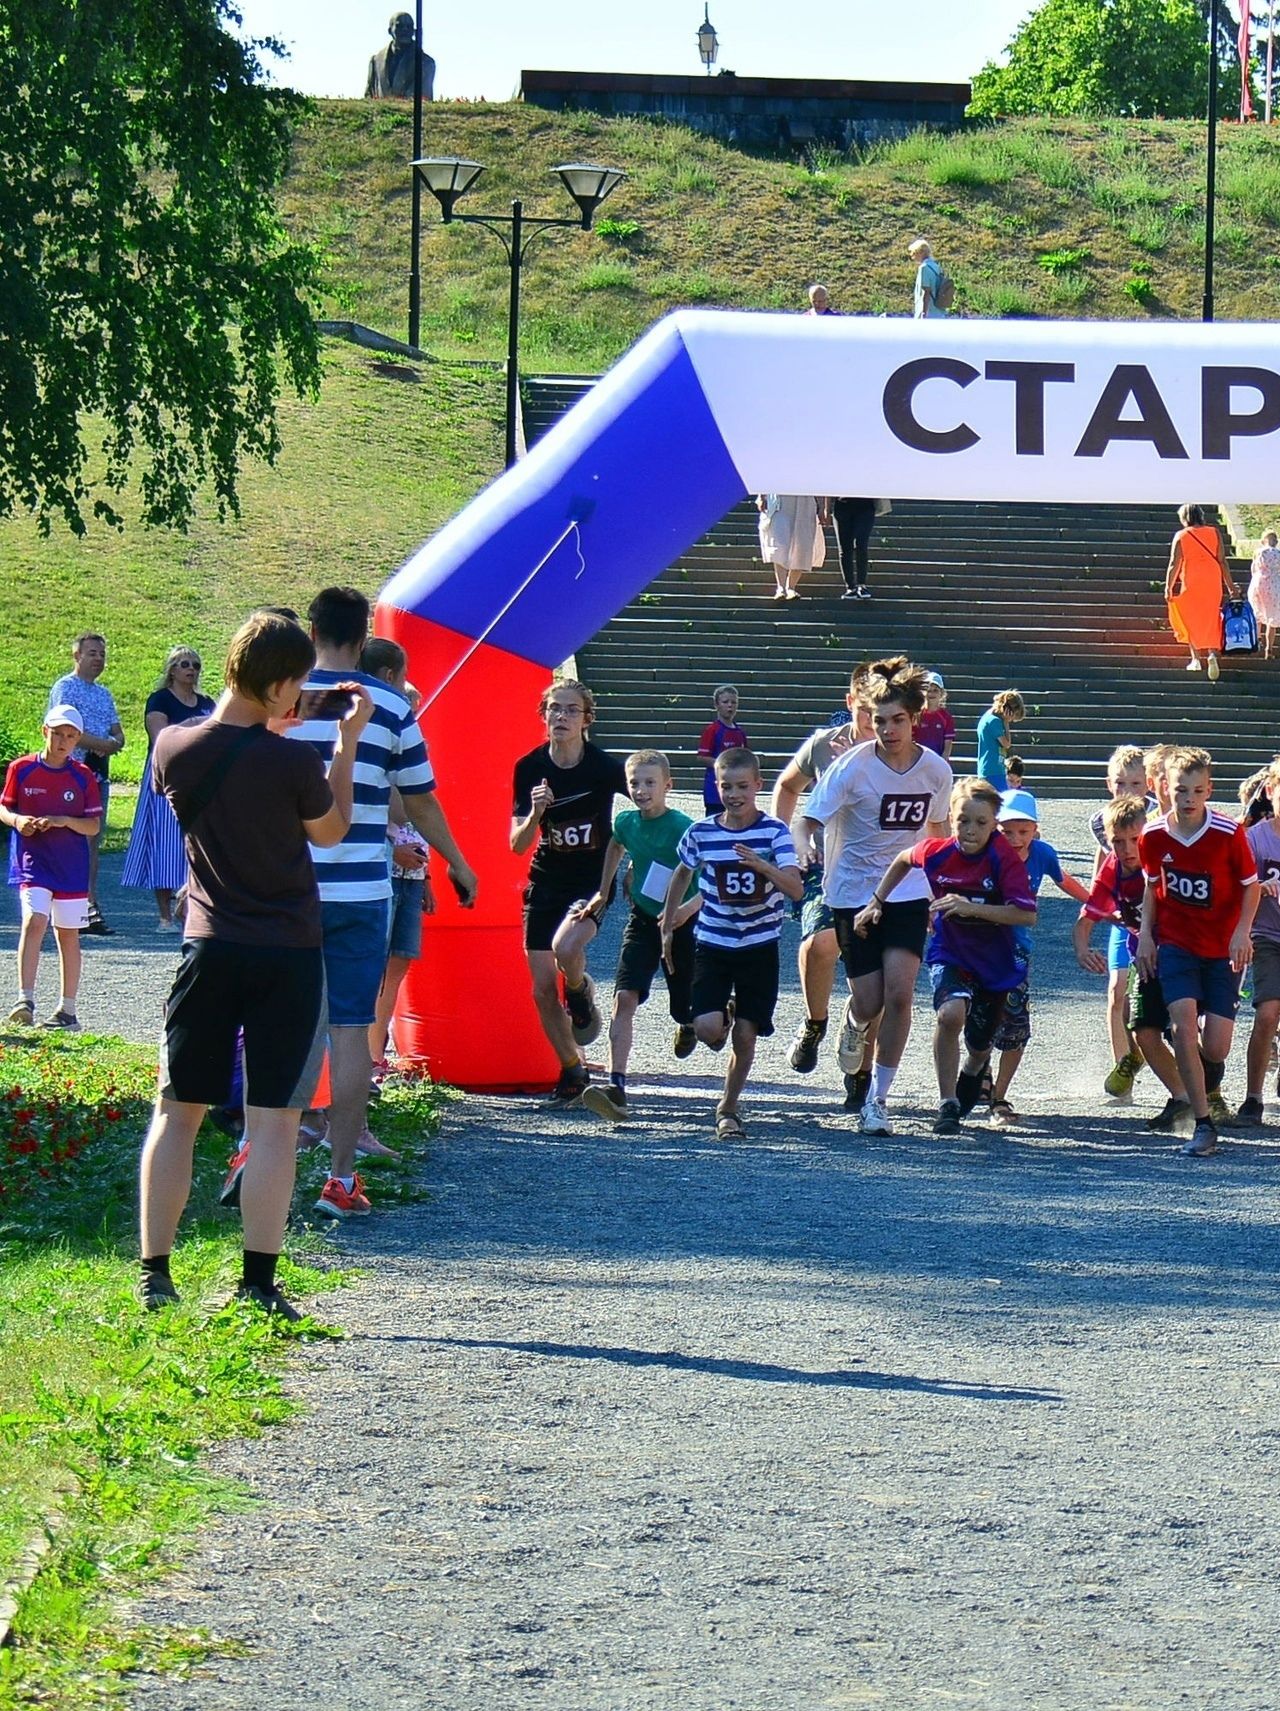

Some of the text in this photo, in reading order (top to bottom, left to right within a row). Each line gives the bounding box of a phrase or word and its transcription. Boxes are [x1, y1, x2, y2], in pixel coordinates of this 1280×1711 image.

[885, 801, 925, 822] 173
[726, 872, 755, 895] 53
[1167, 872, 1208, 899] 203
